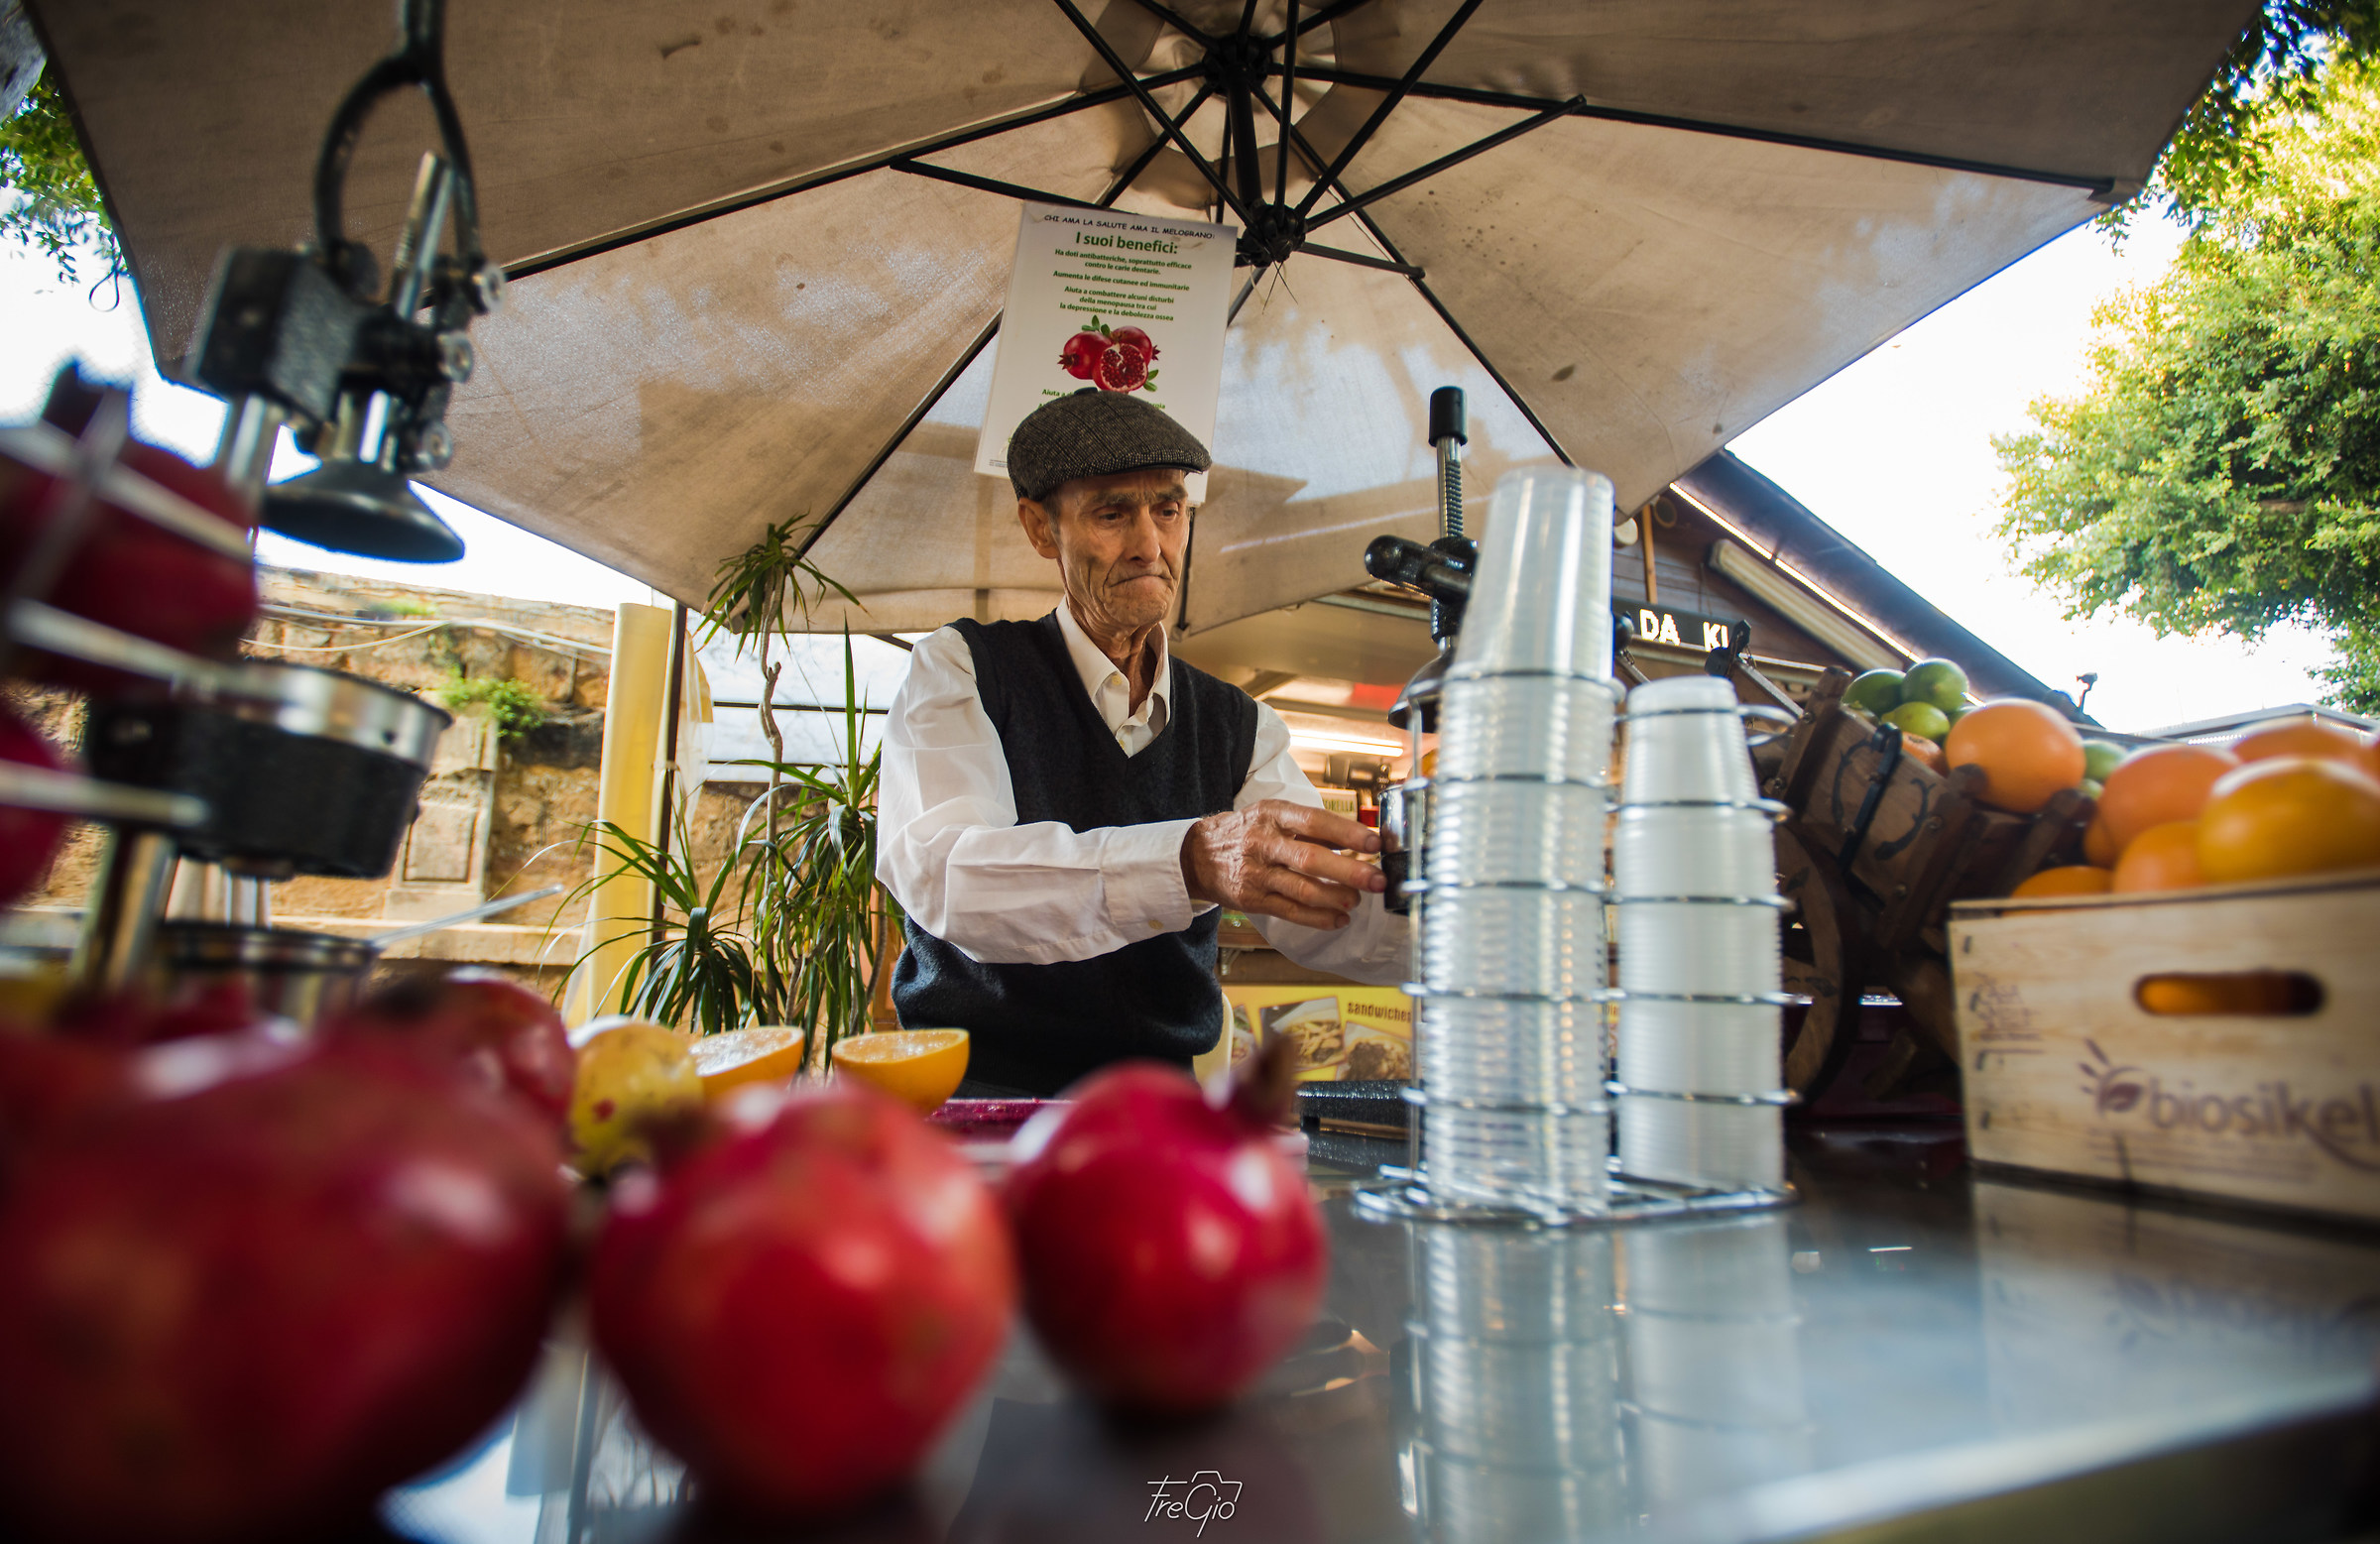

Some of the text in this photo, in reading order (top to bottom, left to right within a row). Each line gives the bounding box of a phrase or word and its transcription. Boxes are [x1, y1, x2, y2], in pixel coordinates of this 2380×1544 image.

[1096, 220, 1128, 230] SALUTE
[1076, 231, 1178, 254] I suoi benefici:
[1079, 252, 1128, 264] antibatteriche,
[1129, 258, 1166, 268] soprattutto
[1166, 261, 1192, 270] efficace
[1131, 266, 1161, 275] dentarie.
[1053, 270, 1083, 280] Aumenta
[1149, 281, 1190, 291] immunitarie
[1089, 290, 1127, 298] combattere
[1128, 293, 1148, 301] alcuni
[1148, 295, 1174, 303] disturbi
[1097, 298, 1135, 308] menopausa
[1067, 302, 1107, 313] depressione
[1121, 309, 1153, 319] debolezza
[1639, 608, 1681, 646] DA
